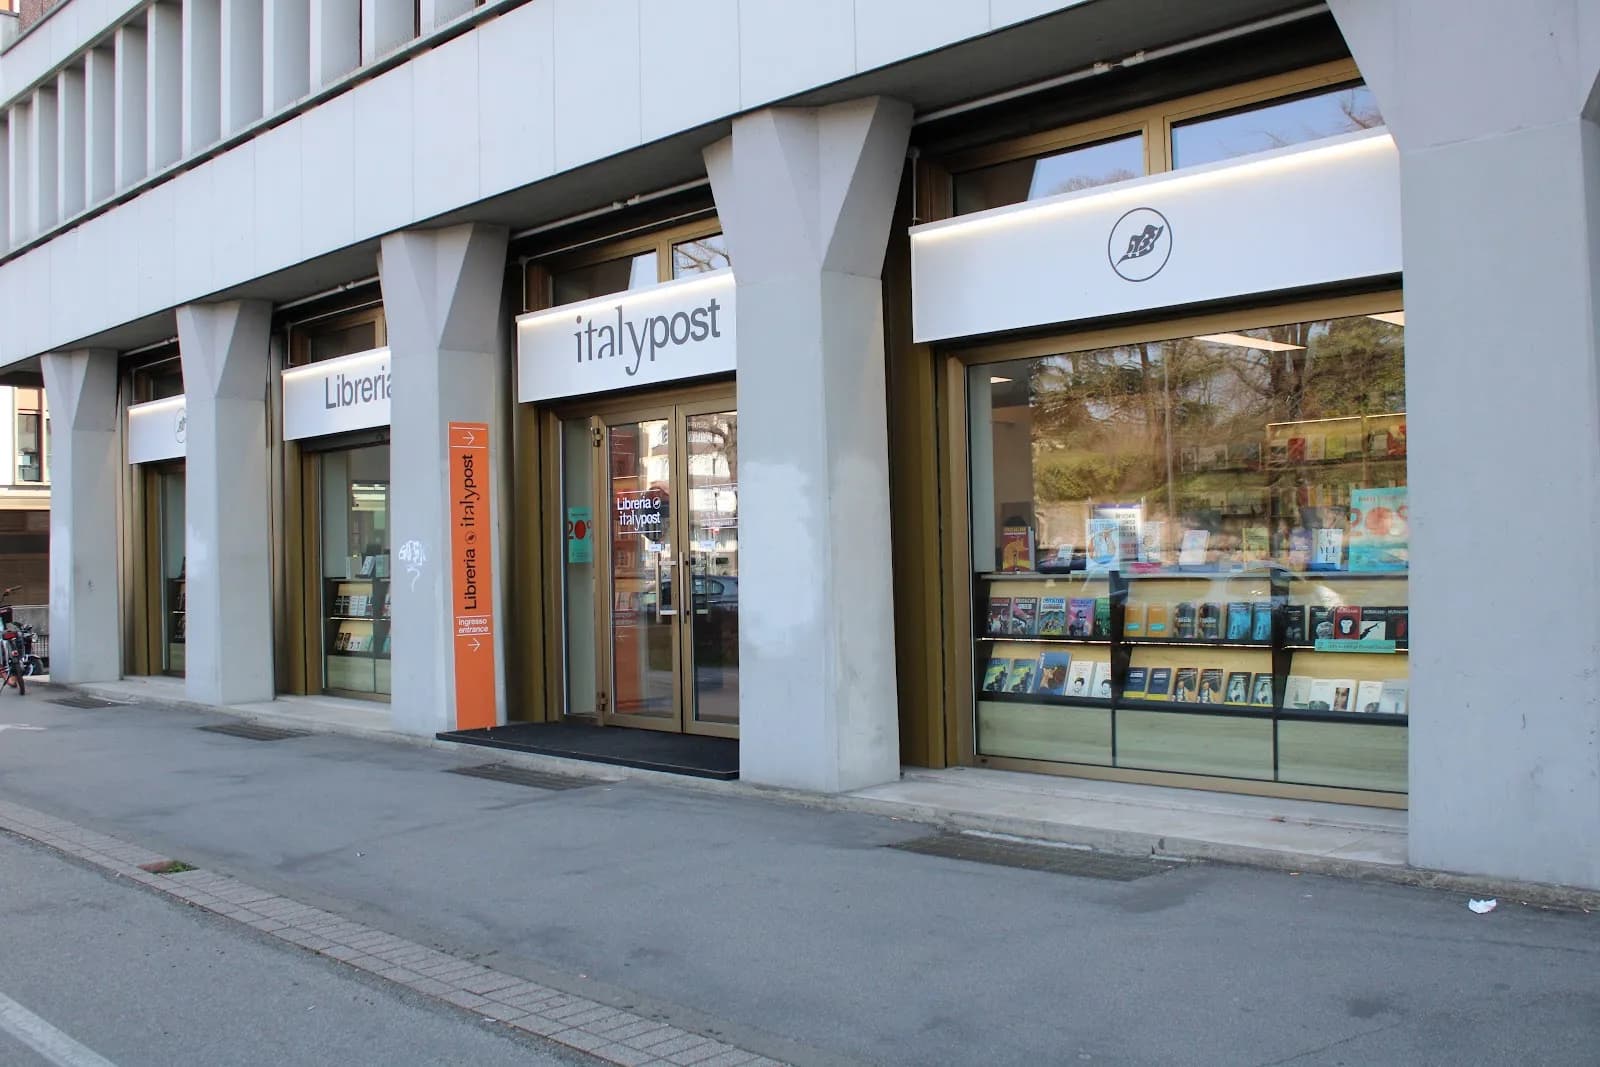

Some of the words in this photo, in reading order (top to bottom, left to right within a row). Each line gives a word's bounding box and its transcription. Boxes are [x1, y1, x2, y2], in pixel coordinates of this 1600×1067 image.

[574, 298, 721, 376] italypost
[459, 454, 480, 527] italypost
[616, 495, 652, 511] Libreria
[619, 510, 661, 531] italypost
[464, 548, 477, 610] Libreria
[458, 617, 488, 627] ingresso
[458, 625, 489, 634] entrance
